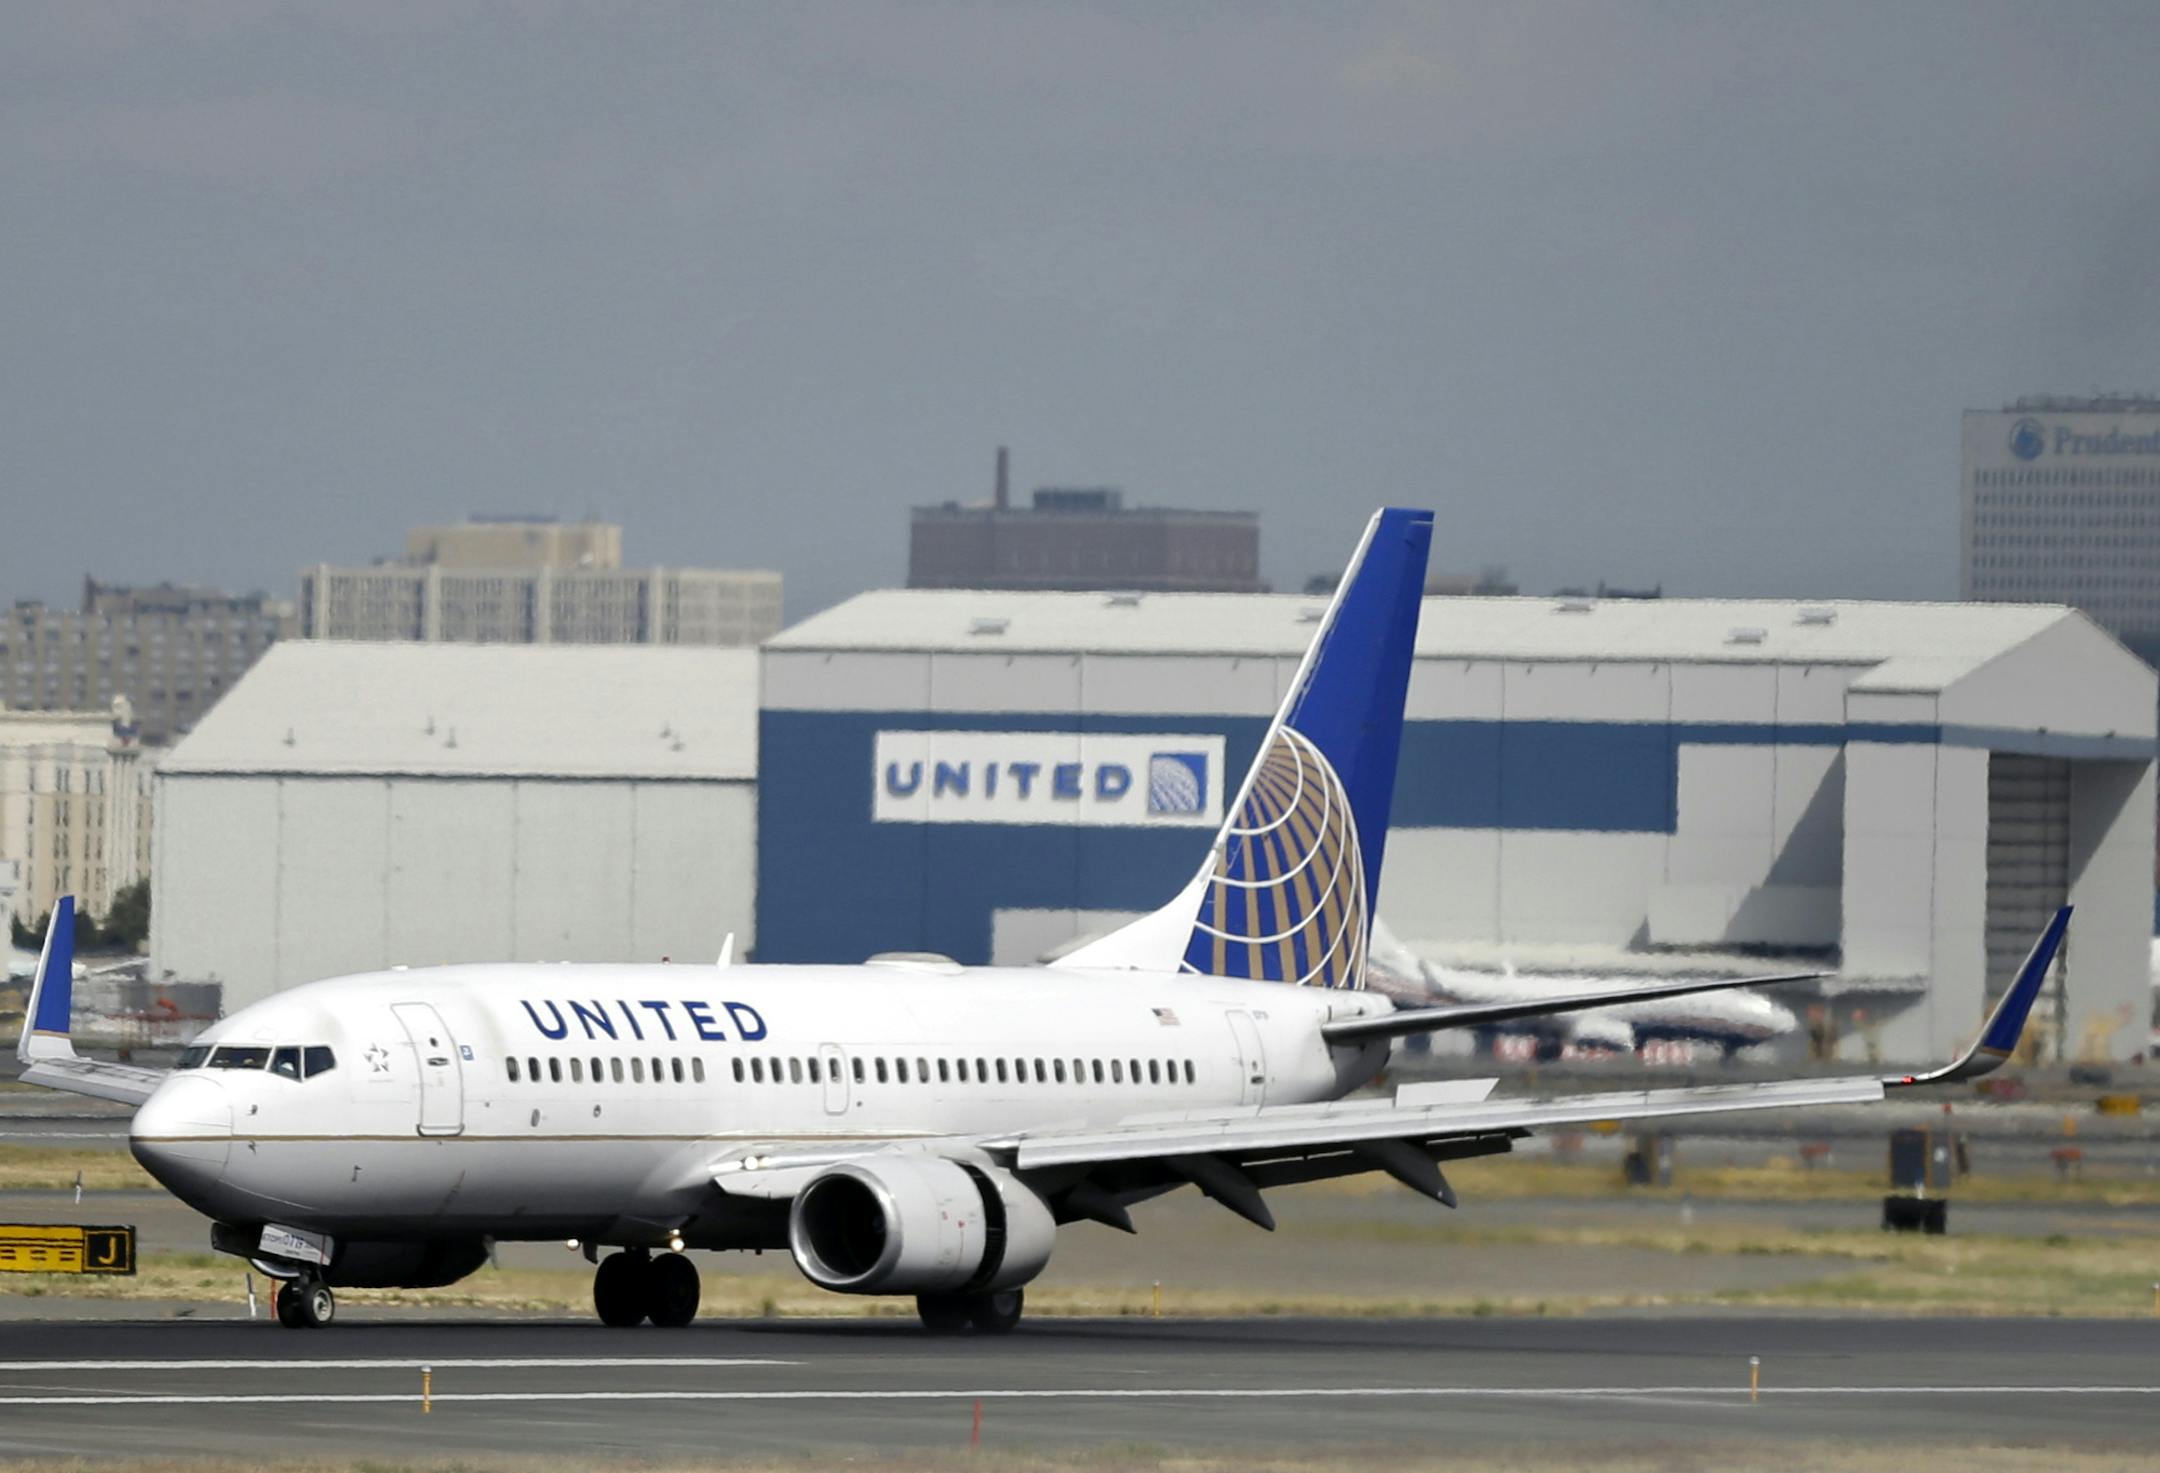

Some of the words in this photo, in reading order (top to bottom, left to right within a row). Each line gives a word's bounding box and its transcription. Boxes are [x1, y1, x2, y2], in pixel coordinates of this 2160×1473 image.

[886, 761, 1132, 799] UNITED
[519, 1000, 768, 1041] UNITED
[98, 1236, 117, 1265] J
